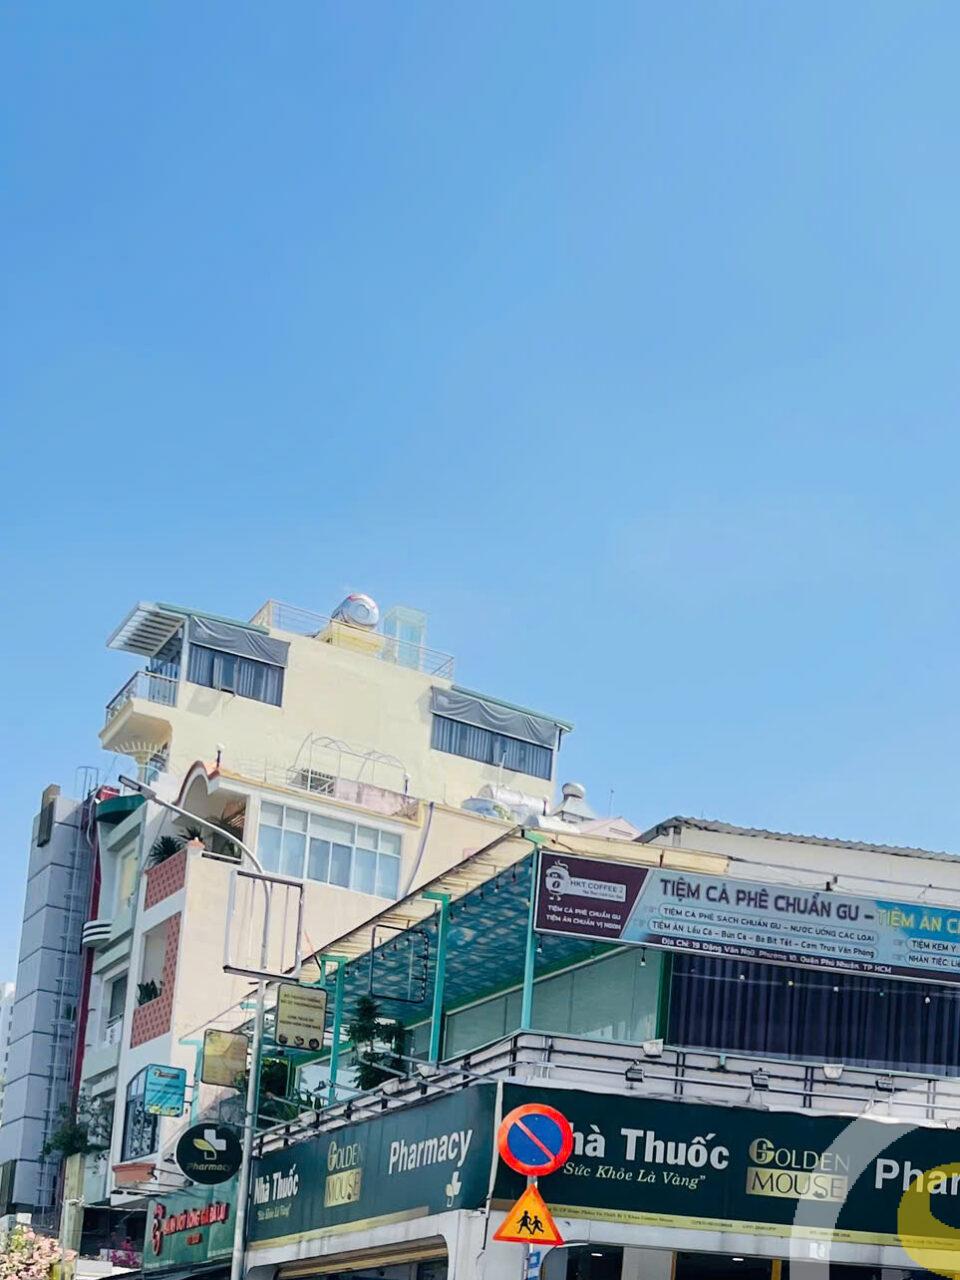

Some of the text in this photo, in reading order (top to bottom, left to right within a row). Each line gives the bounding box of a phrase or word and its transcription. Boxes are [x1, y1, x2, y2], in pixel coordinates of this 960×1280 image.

[570, 880, 586, 888] HKT
[588, 881, 617, 893] COFFEE
[575, 908, 587, 916] PHÊ
[660, 877, 701, 902] TIỆM
[736, 888, 769, 910] PHÊ
[774, 892, 832, 918] CHUẨN
[836, 903, 860, 921] GU
[877, 907, 915, 931] TIỆM
[604, 922, 621, 930] NGON
[770, 922, 781, 930] GU
[932, 942, 948, 952] KEM
[874, 965, 892, 974] HCM
[388, 1129, 474, 1174] Pharmacy
[566, 1122, 730, 1170] hà Thuốc
[749, 1137, 850, 1172] GOLDEN
[253, 1163, 299, 1205] Nhà Thuốc
[595, 1164, 633, 1181] Khỏe
[637, 1169, 657, 1184] Là
[751, 1171, 847, 1200] MOUSE
